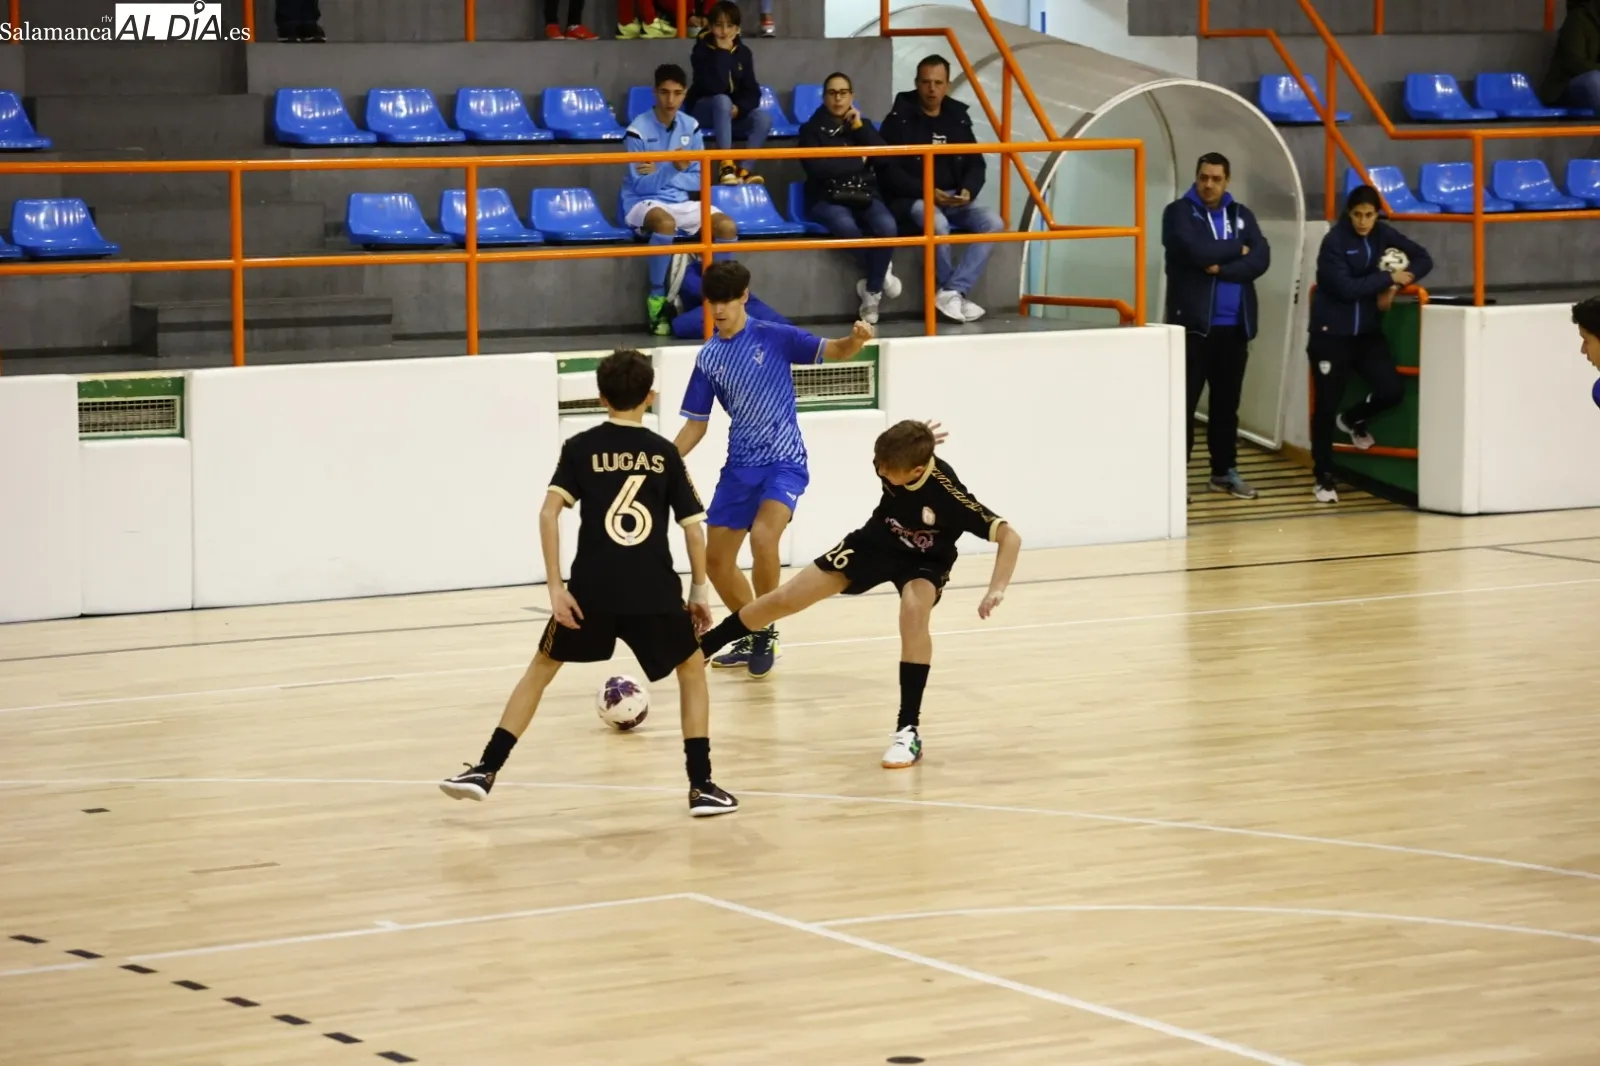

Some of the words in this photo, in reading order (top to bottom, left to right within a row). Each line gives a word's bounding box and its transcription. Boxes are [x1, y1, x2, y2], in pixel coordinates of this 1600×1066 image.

[592, 451, 665, 474] LUCAS
[604, 474, 653, 547] 6
[825, 540, 855, 569] 26
